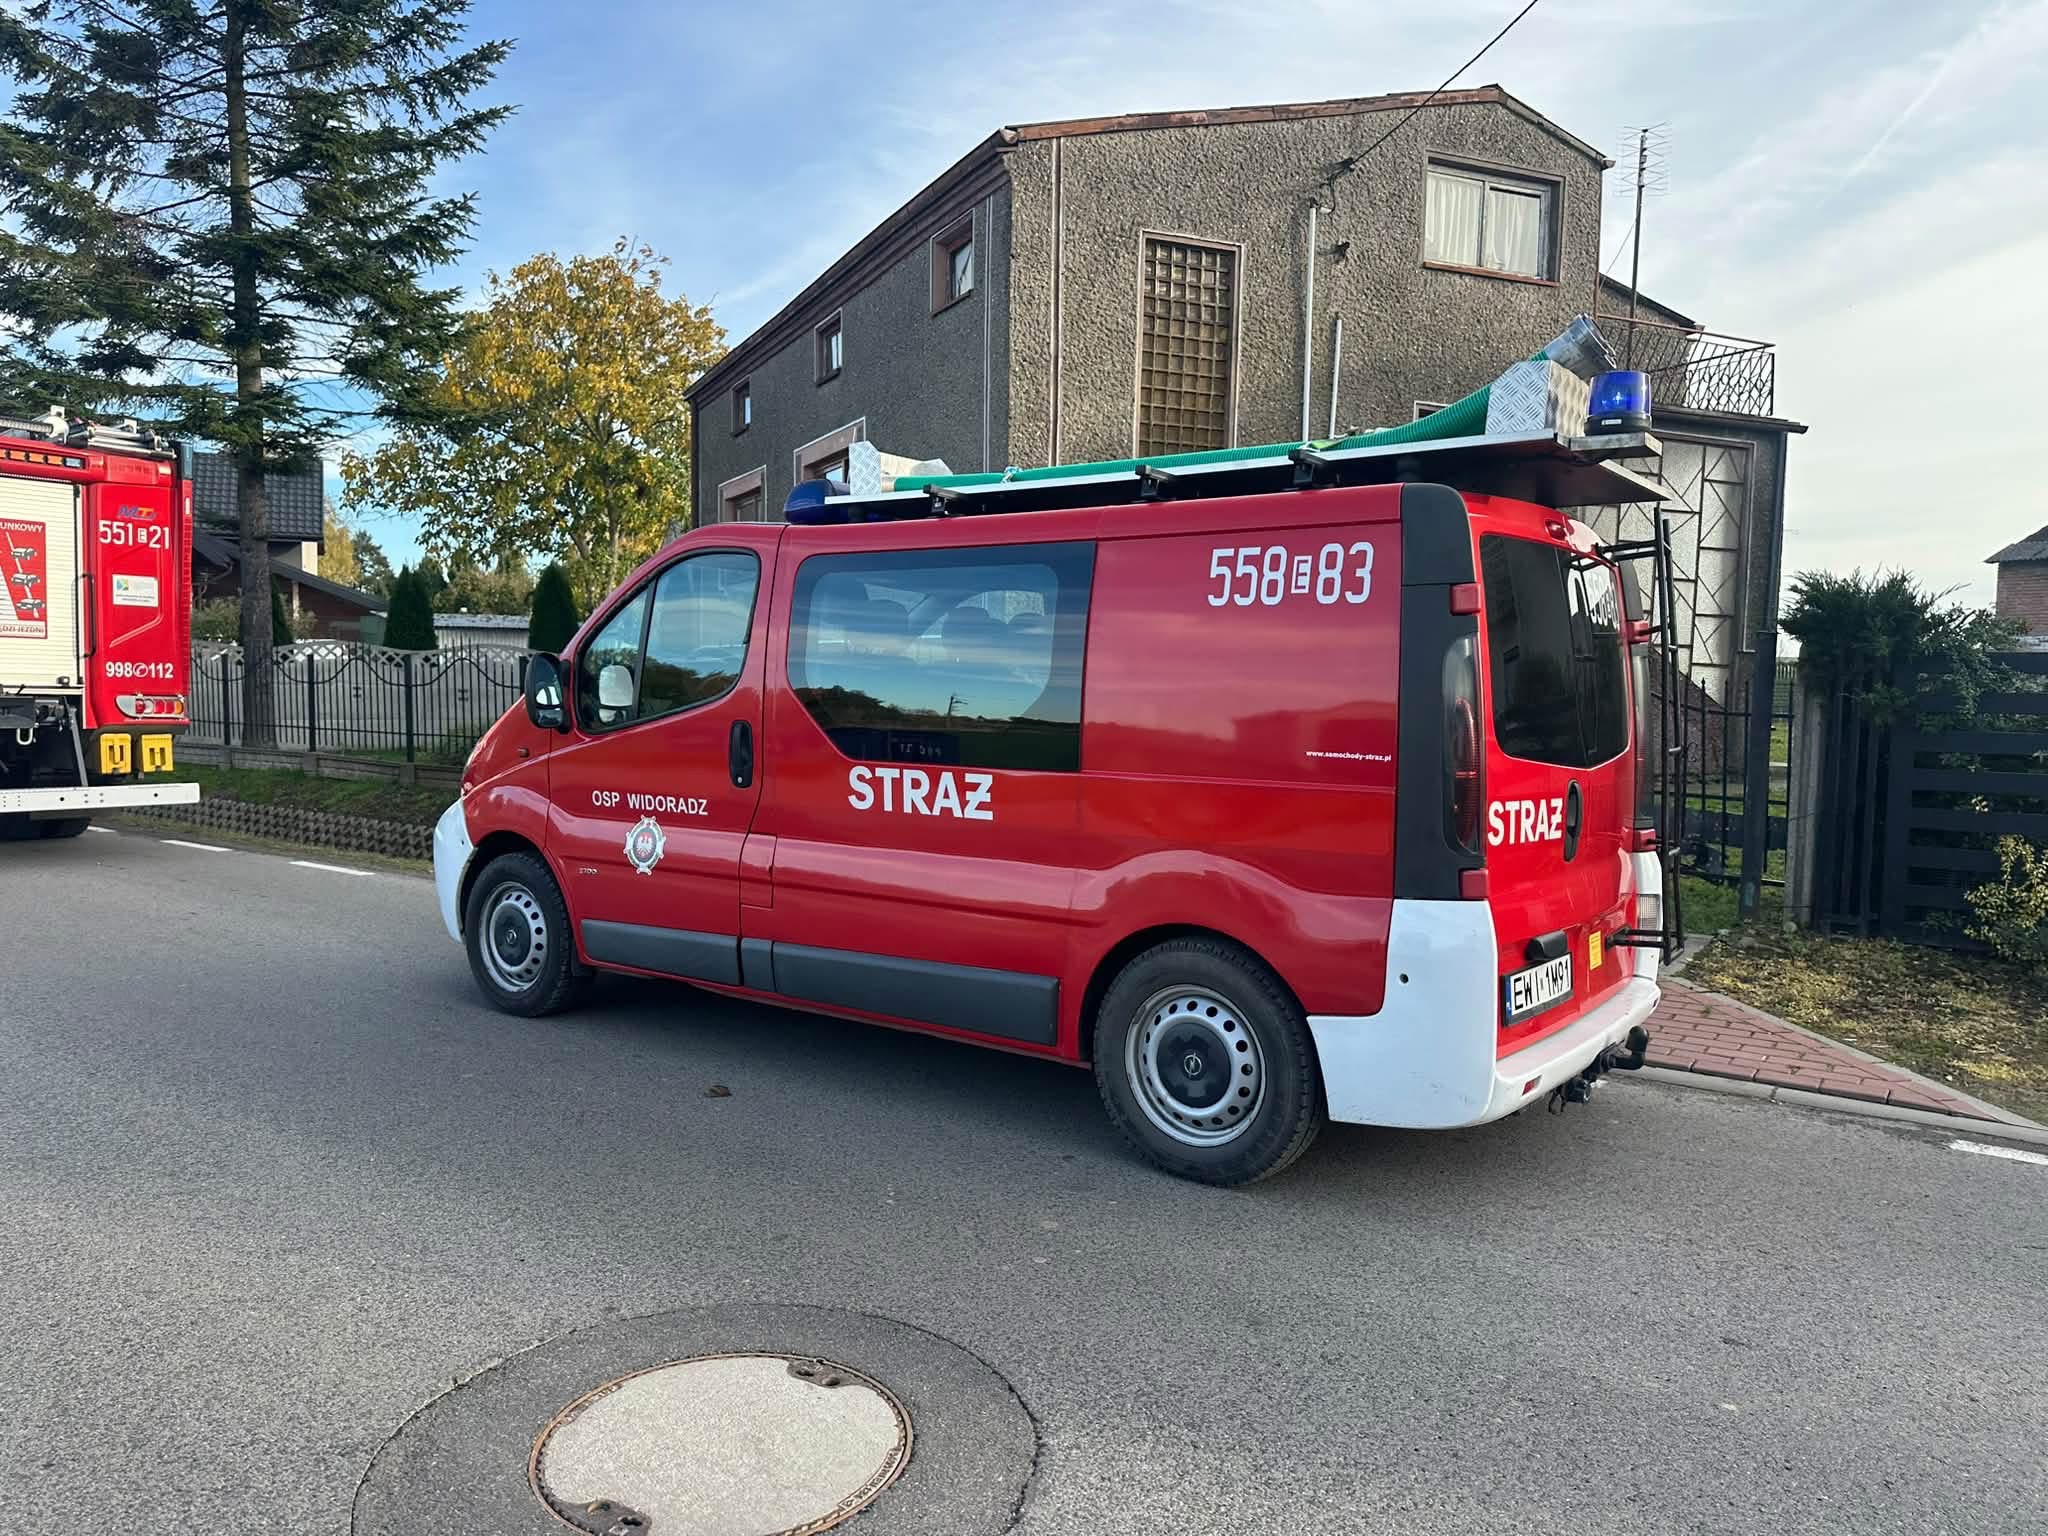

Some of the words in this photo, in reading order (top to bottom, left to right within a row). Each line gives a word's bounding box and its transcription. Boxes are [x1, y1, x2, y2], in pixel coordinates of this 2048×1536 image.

[105, 661, 133, 678] 998
[148, 662, 174, 679] 112
[1305, 750, 1392, 762] www.samochody-straz.pl
[591, 789, 620, 807] OSP
[626, 792, 709, 816] WIDORADZ
[1512, 970, 1540, 1011] EWI
[1545, 957, 1571, 998] 1M91
